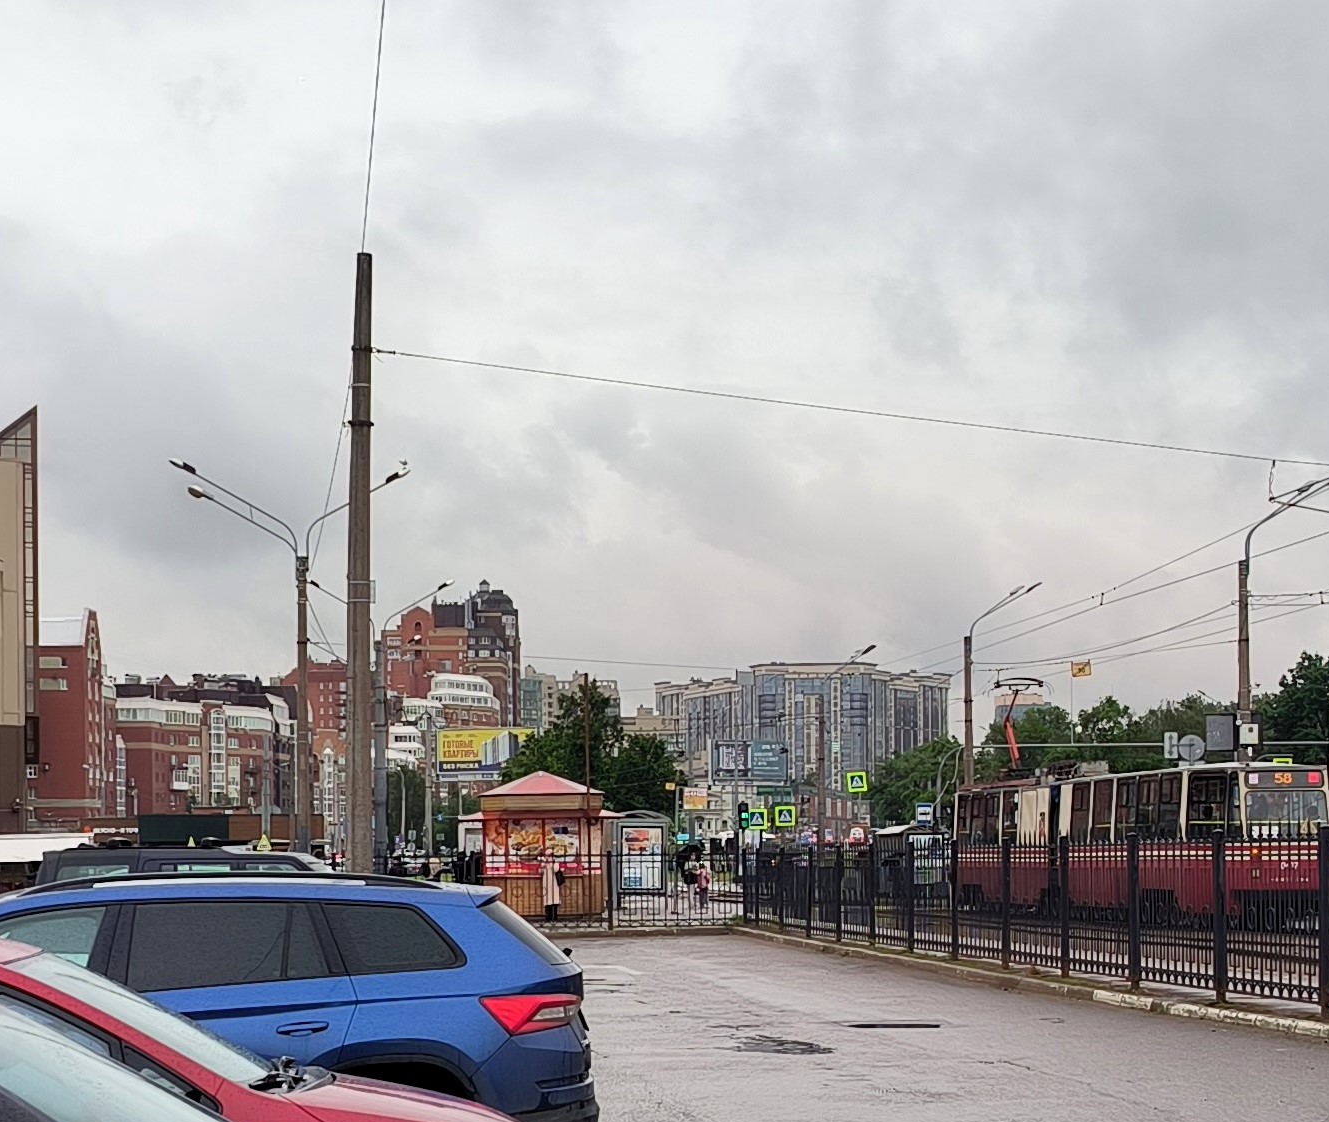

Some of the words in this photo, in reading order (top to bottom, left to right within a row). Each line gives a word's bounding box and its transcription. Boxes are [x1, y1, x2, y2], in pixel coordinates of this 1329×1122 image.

[442, 740, 474, 749] ГОТОВЫЕ
[442, 750, 479, 758] КВАРТИРЫ
[1274, 772, 1292, 784] 58
